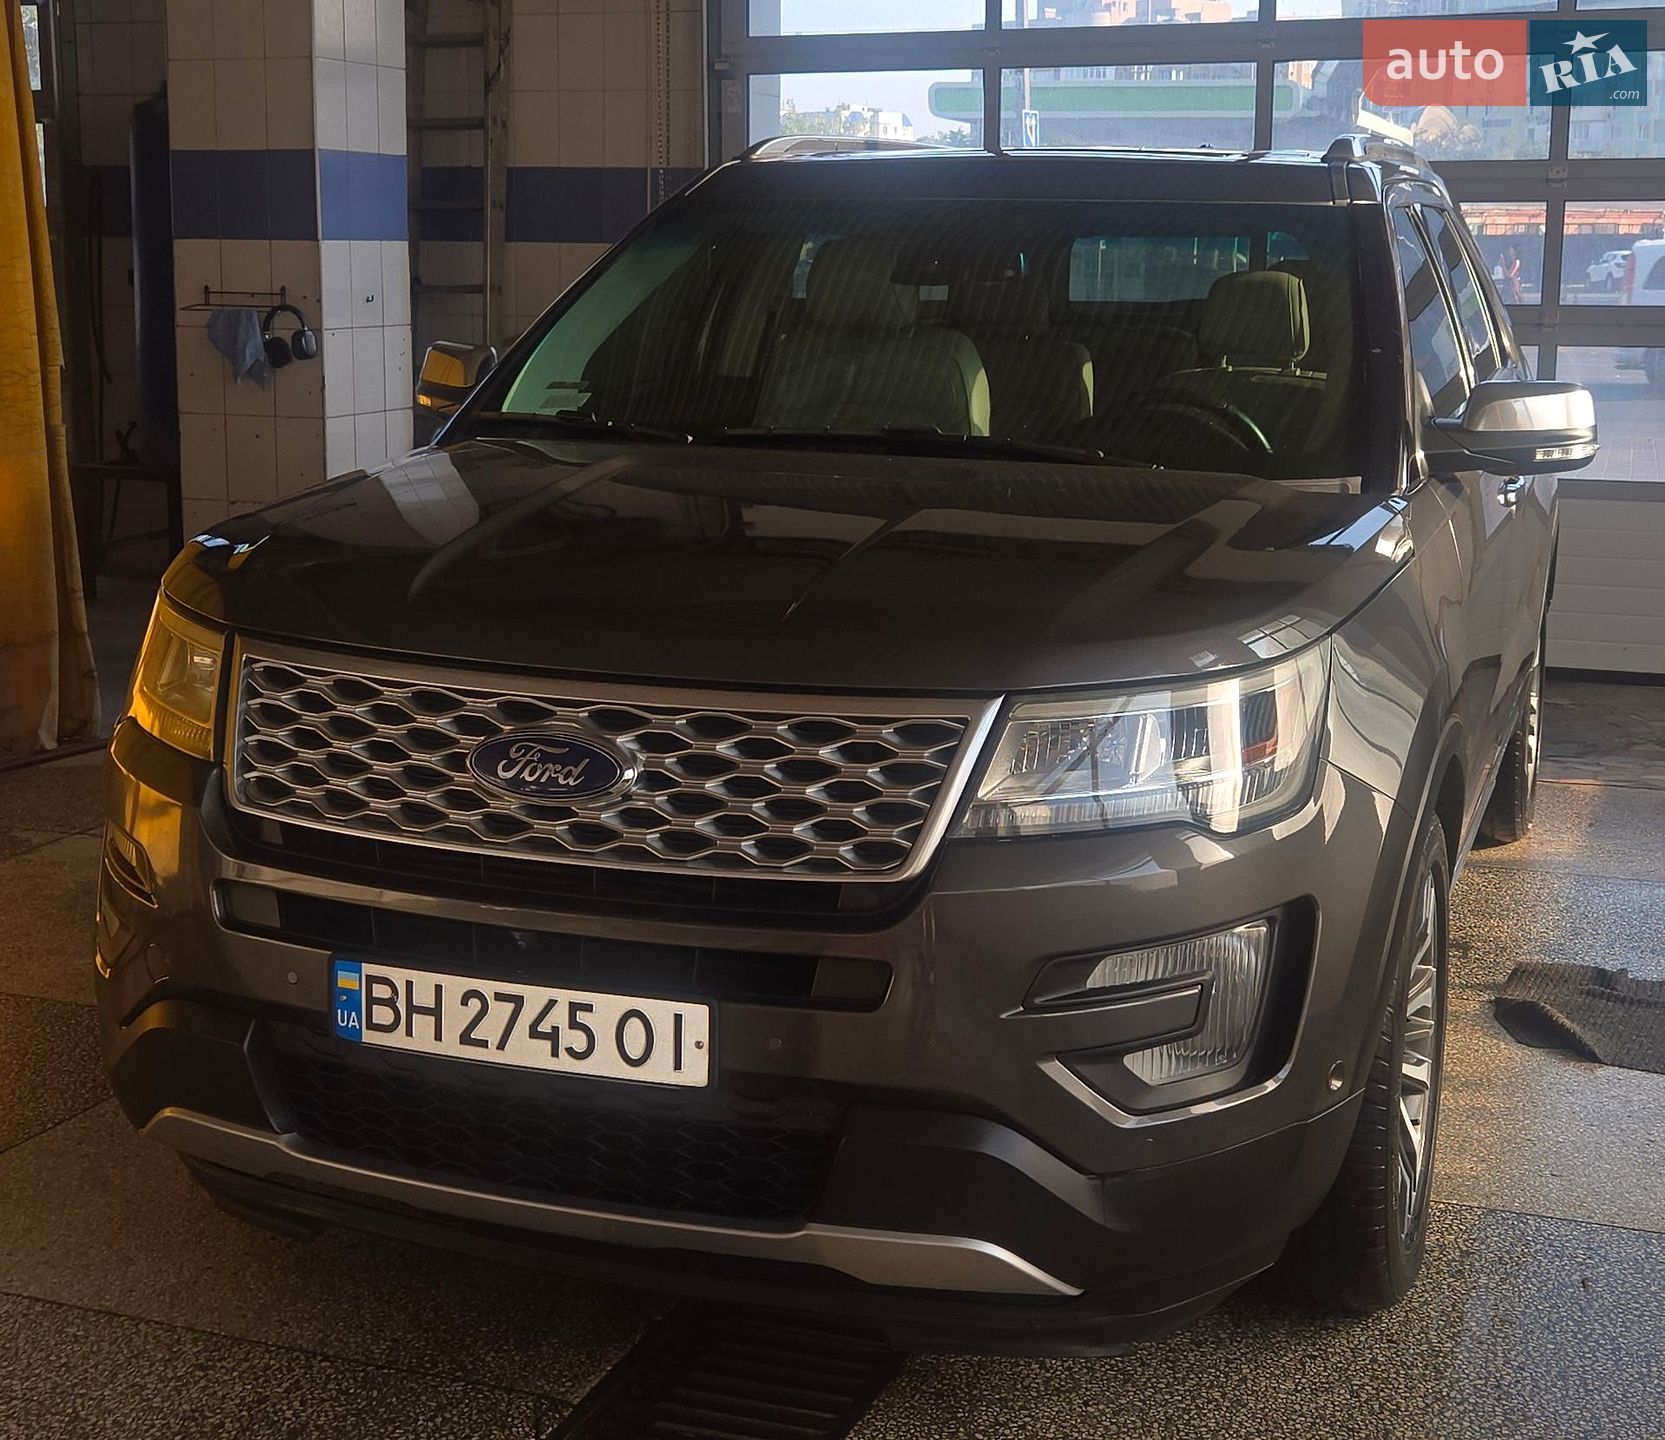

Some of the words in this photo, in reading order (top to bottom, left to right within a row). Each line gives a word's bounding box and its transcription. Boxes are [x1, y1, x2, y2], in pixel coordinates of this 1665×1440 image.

[497, 742, 590, 786] Ford
[337, 1008, 360, 1029] UA
[364, 974, 444, 1043] BH
[459, 988, 597, 1061] 2745
